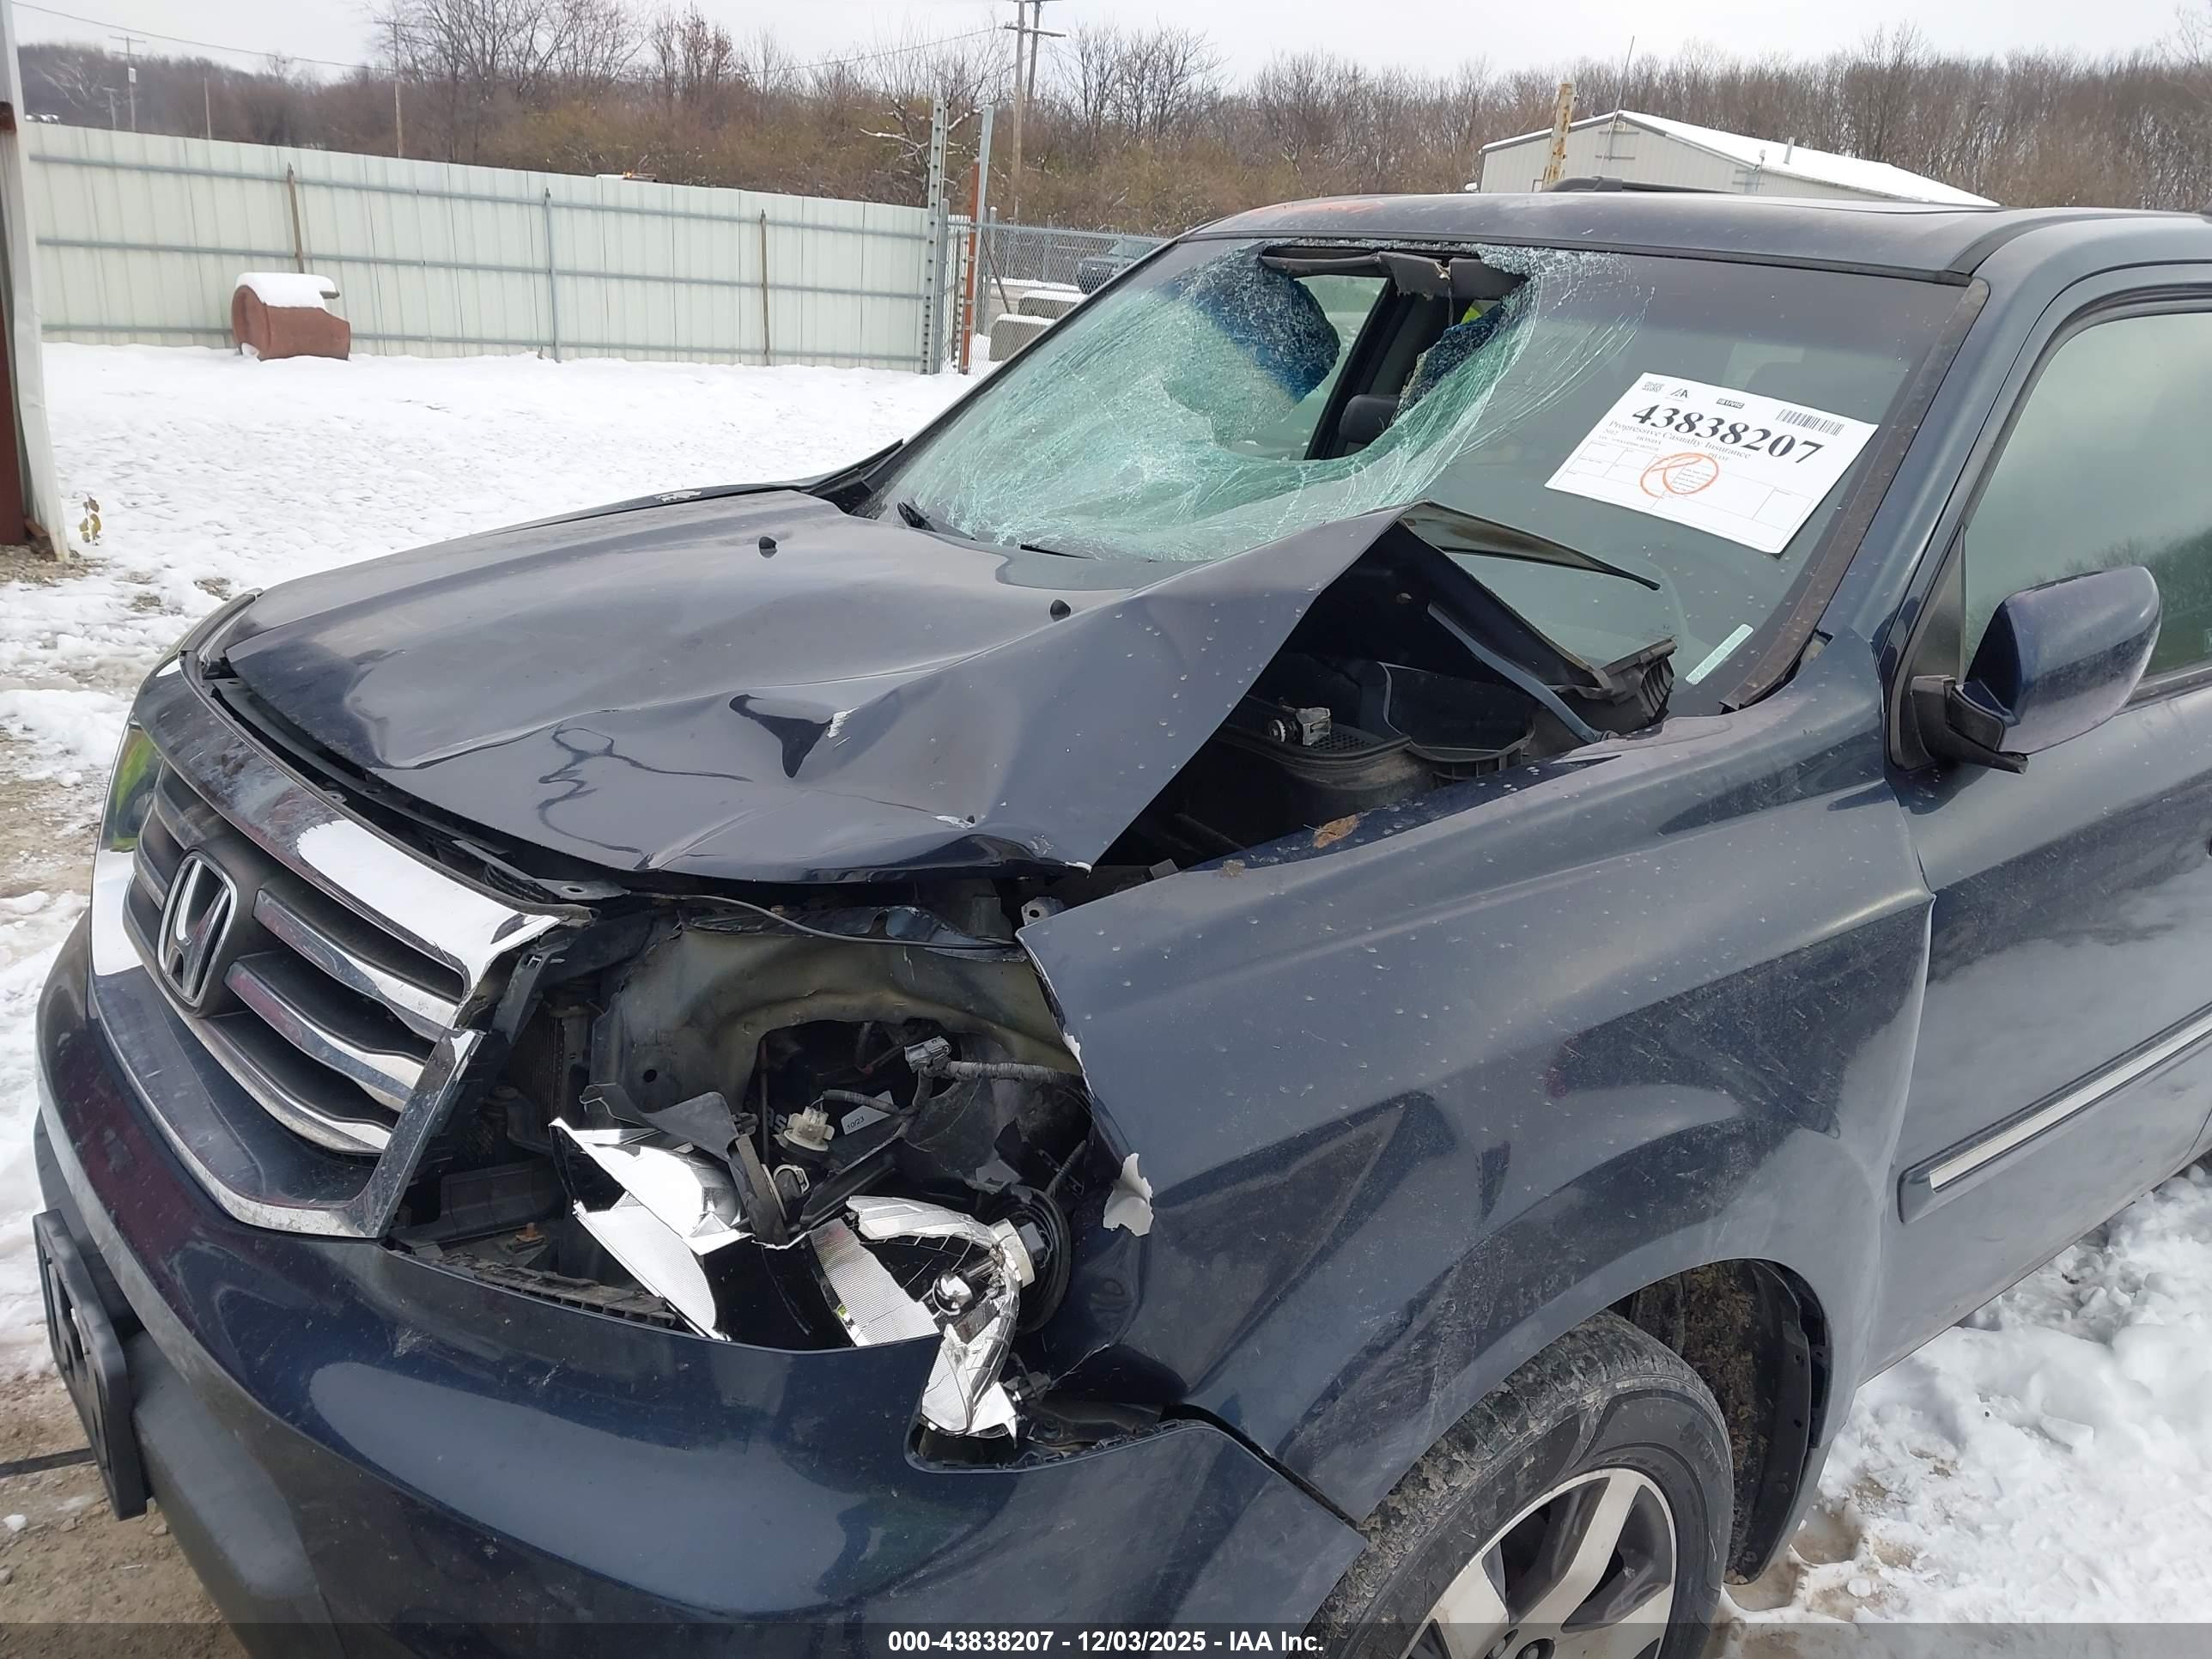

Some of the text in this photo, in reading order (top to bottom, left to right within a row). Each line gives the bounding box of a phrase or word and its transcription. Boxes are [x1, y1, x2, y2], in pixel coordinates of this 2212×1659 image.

[1609, 421, 1662, 437] Progressive
[1662, 431, 1703, 447] Casualty
[1705, 441, 1752, 461] Insurance
[1632, 404, 1825, 464] 43838207
[847, 1115, 865, 1129] 10/23
